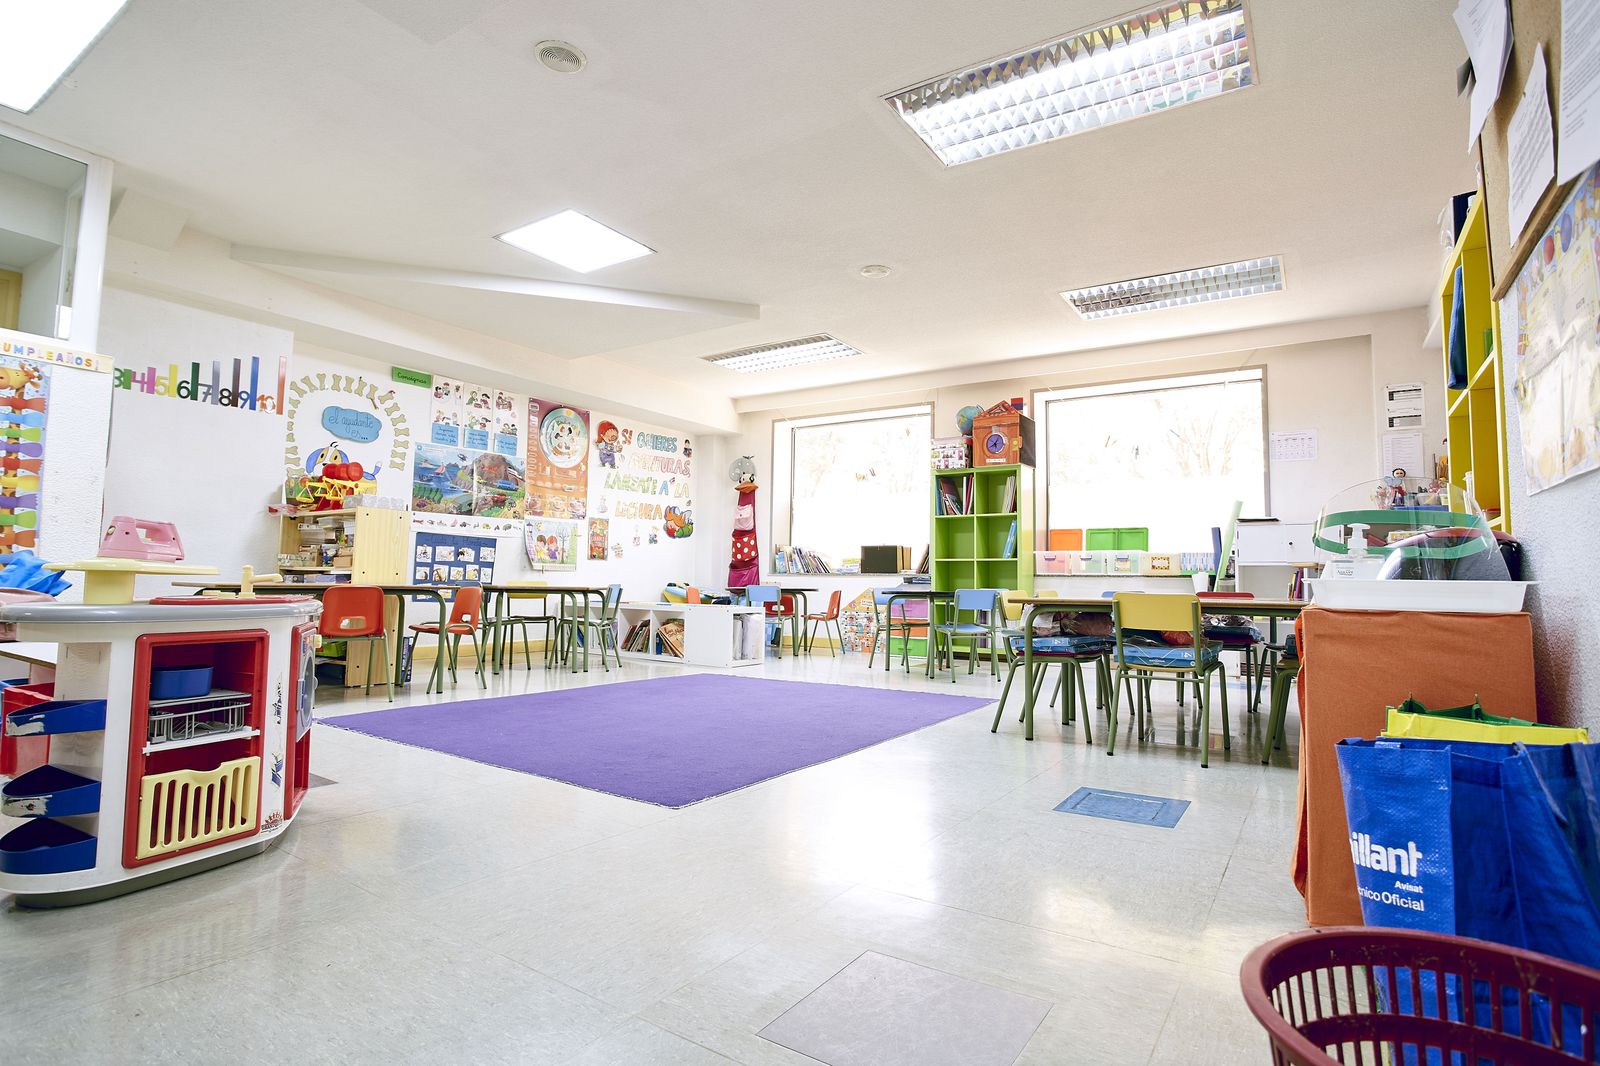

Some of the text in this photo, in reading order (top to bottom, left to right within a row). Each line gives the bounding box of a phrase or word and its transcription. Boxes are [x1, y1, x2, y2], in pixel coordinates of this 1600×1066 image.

[155, 376, 168, 396] 5
[176, 380, 191, 399] 6
[219, 388, 231, 407] 8
[239, 390, 250, 409] 9
[637, 432, 678, 453] QUIERES
[658, 480, 669, 496] A
[674, 482, 690, 498] LA
[1349, 831, 1423, 878] illant
[1394, 880, 1424, 894] Avisat
[1381, 891, 1425, 912] Oficial
